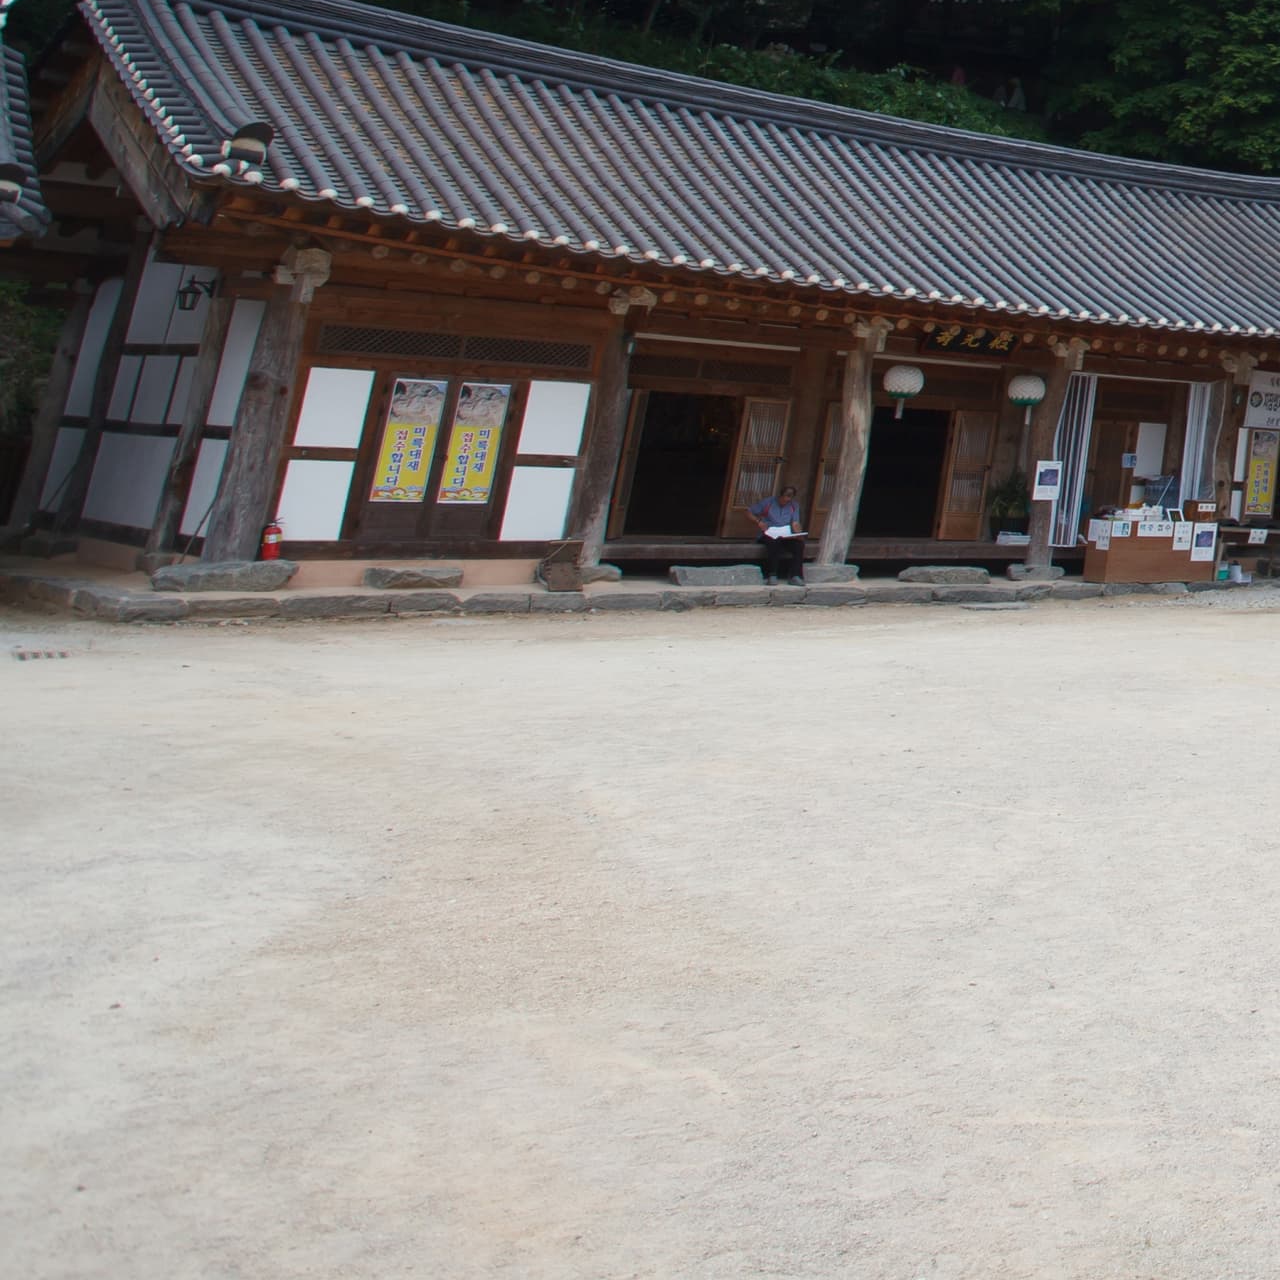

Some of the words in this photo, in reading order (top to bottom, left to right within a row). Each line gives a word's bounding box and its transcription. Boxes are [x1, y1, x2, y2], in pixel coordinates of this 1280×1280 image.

[386, 430, 408, 486] 접수합니다
[407, 426, 426, 472] 미륵대재
[453, 432, 474, 487] 접수합니다
[473, 429, 491, 473] 미륵대재
